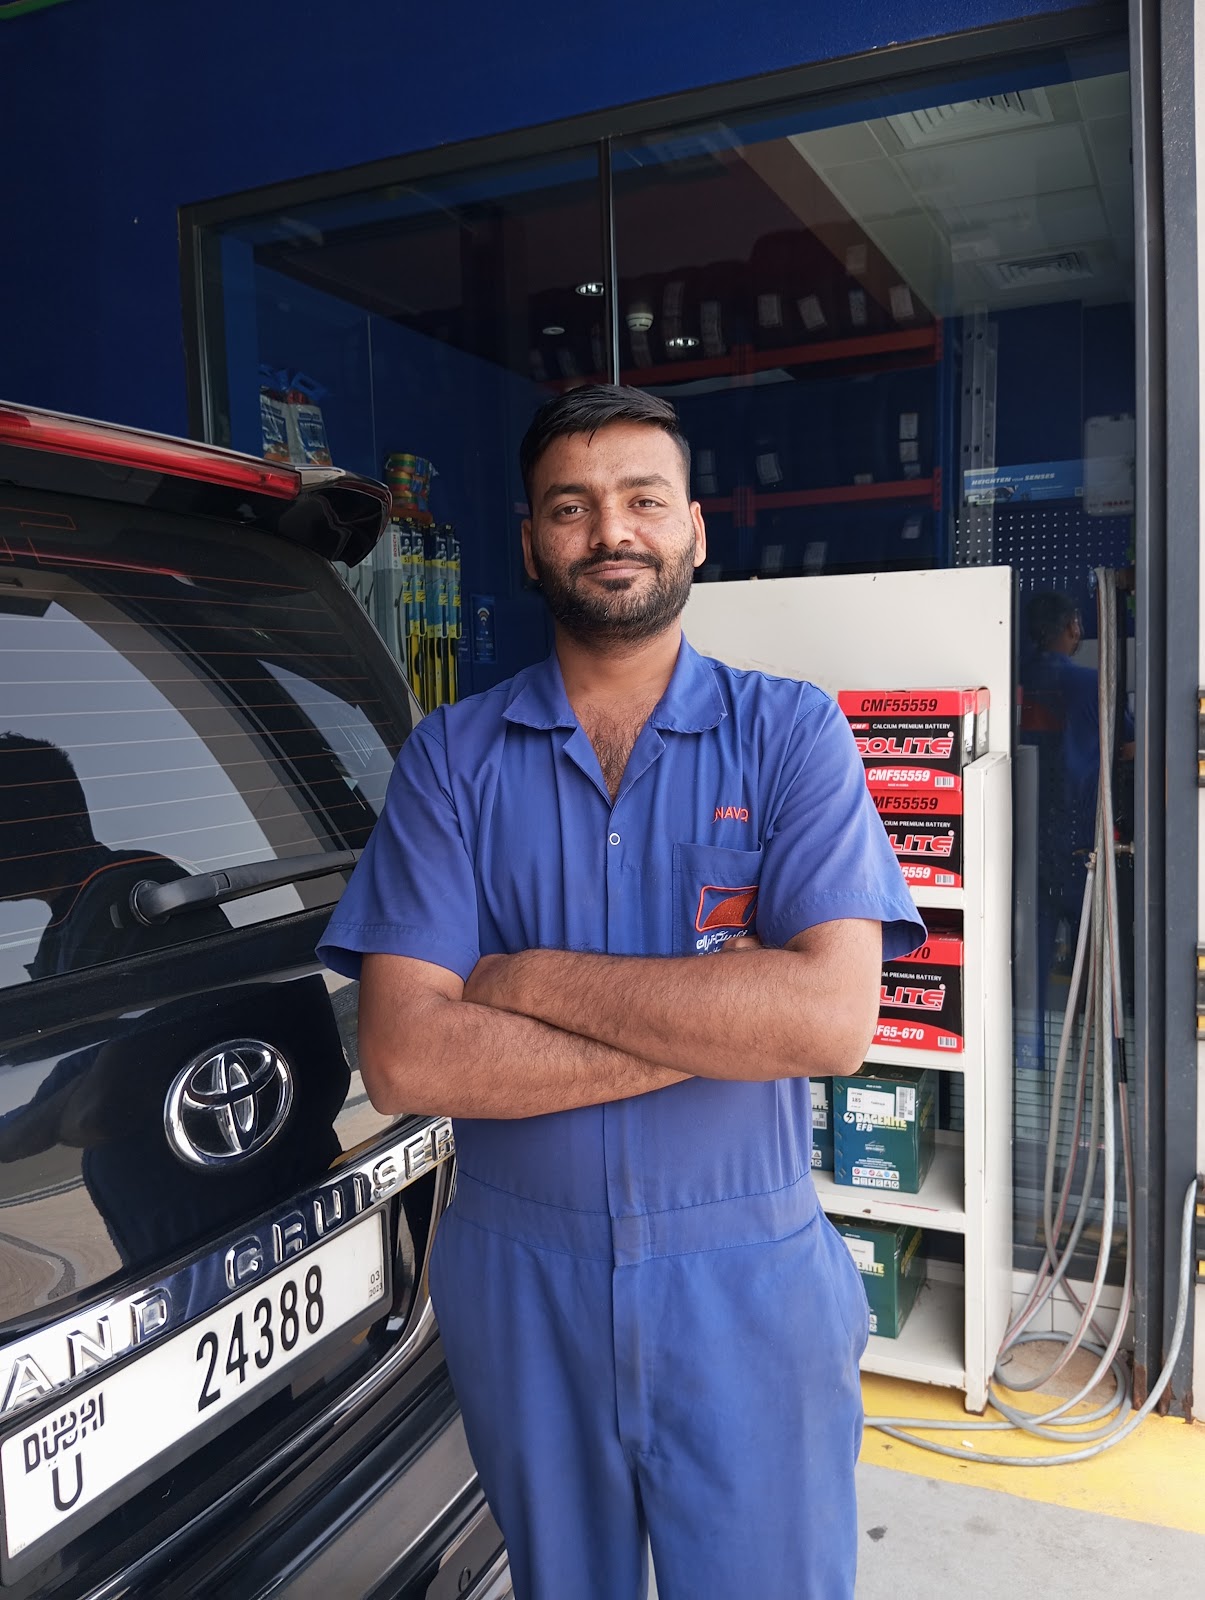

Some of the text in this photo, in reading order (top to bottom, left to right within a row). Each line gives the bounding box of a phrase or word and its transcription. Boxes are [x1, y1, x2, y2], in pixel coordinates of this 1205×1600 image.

[971, 476, 1011, 486] HEIGHTEN
[1024, 472, 1056, 482] SENSES
[861, 698, 938, 712] CMF55559
[868, 769, 930, 782] CMF55559
[873, 796, 938, 810] MF55559
[900, 866, 932, 878] 5559
[874, 1025, 924, 1040] F65-670
[856, 1122, 873, 1132] EFB
[225, 1118, 456, 1290] CRUISER
[370, 1270, 380, 1284] 03
[196, 1264, 324, 1413] 24388
[52, 1452, 83, 1512] U
